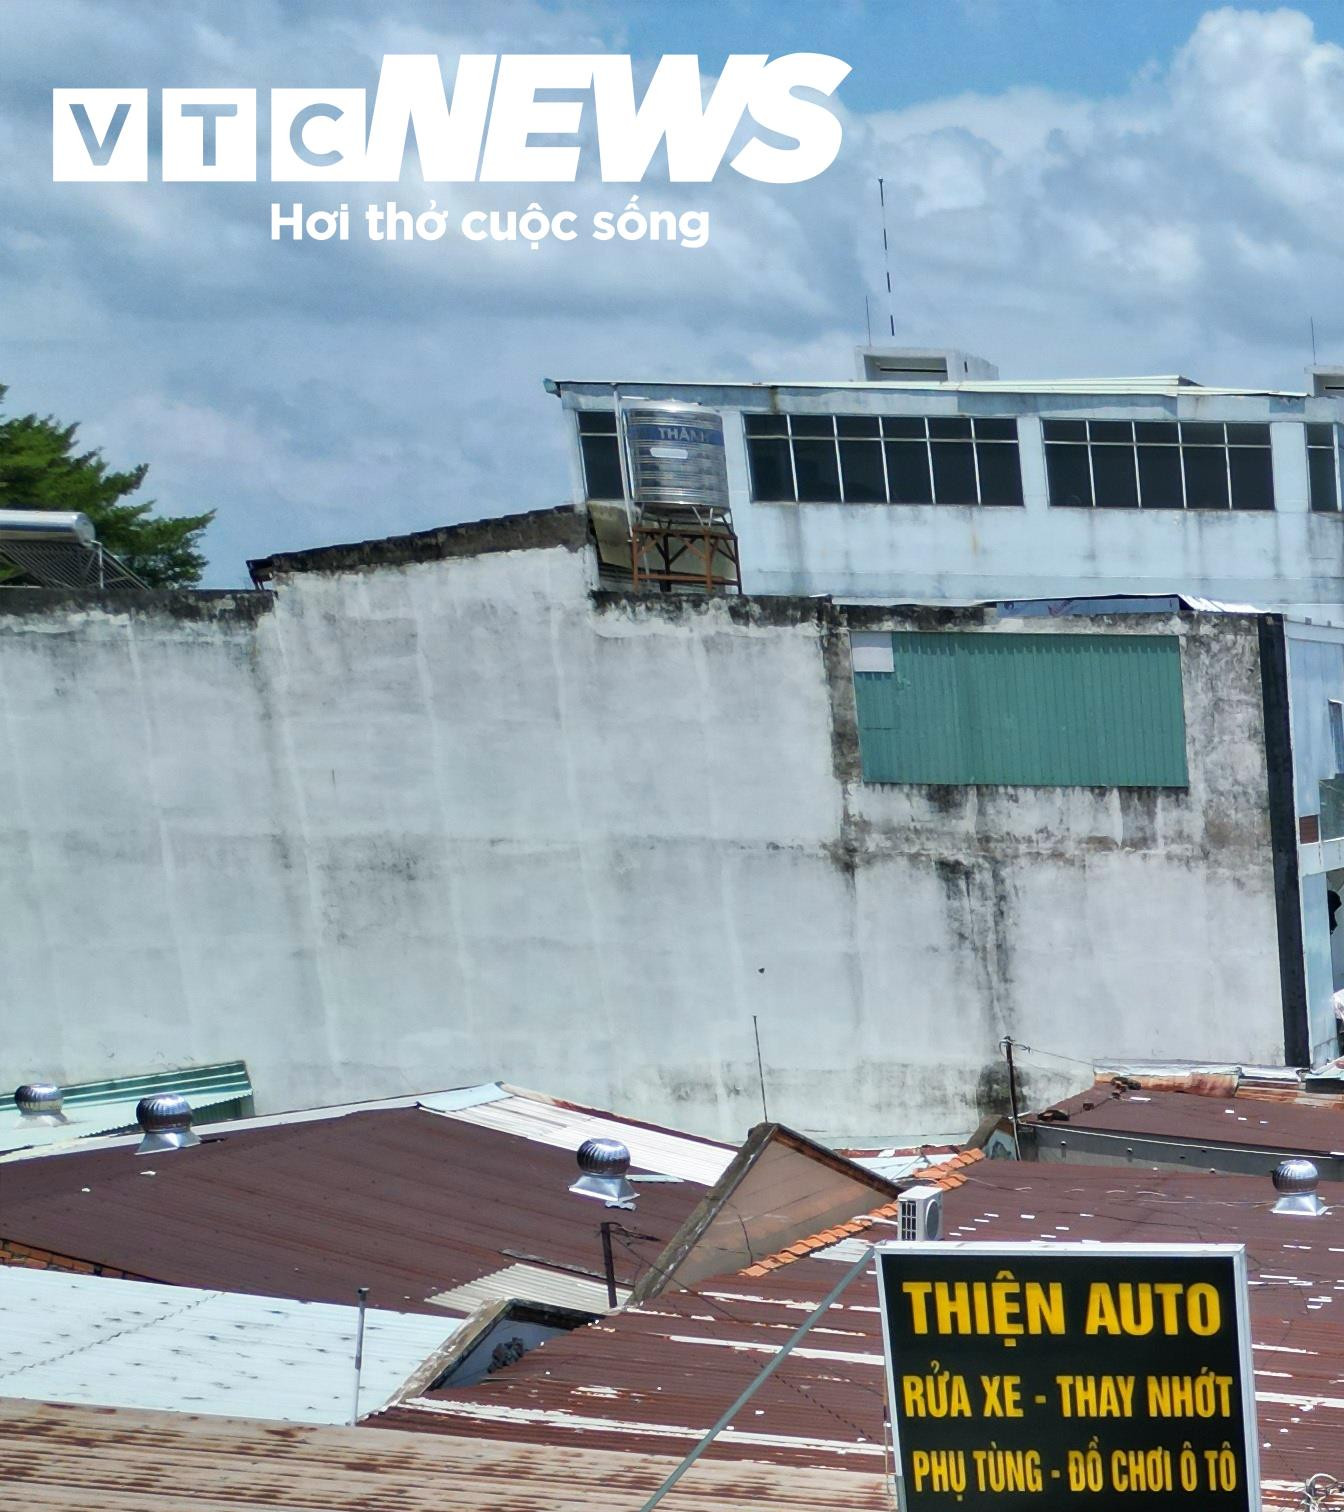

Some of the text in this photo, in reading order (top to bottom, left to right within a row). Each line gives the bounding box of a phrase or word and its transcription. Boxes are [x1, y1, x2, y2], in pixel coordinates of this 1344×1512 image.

[902, 1270, 1221, 1347] THIỆN AUTO
[902, 1360, 972, 1418] RỬA
[980, 1375, 1025, 1418] XE
[1056, 1375, 1135, 1418] THAY
[1147, 1366, 1233, 1418] NHỚT
[912, 1450, 968, 1502] PHỤ
[973, 1442, 1043, 1493] TÙNG
[1067, 1435, 1102, 1493] ĐỒ
[1111, 1446, 1173, 1492] CHƠI
[1178, 1442, 1199, 1492] Ô
[1204, 1441, 1238, 1492] TÔ
